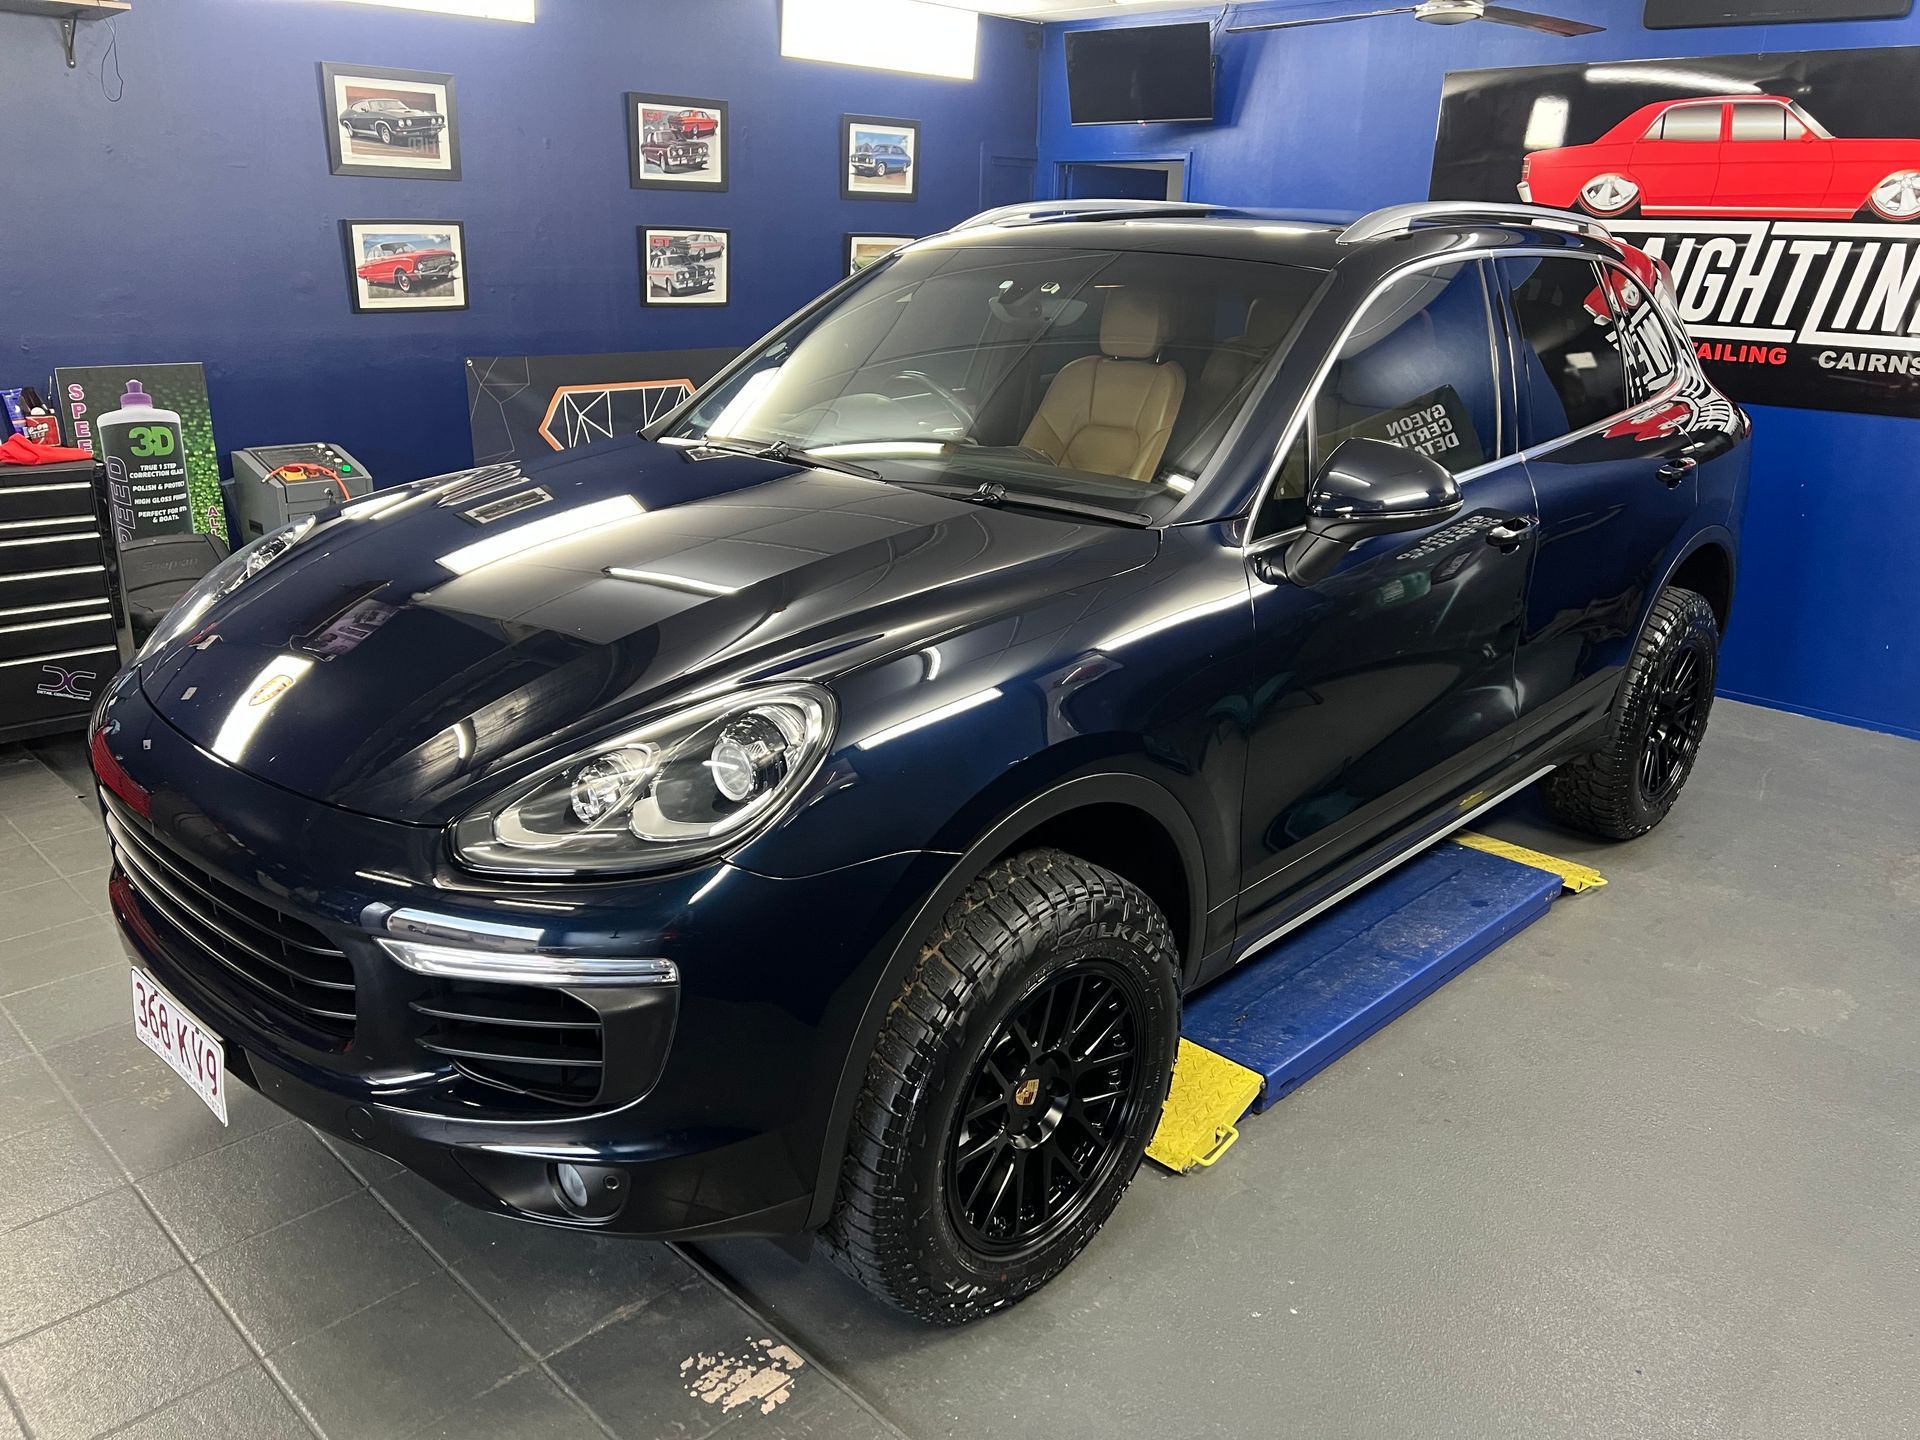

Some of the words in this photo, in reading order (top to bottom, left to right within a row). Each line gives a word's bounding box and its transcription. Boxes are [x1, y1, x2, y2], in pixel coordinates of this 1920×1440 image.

[1818, 350, 1920, 376] CAIRNS
[128, 426, 174, 457] 3D
[163, 462, 177, 470] STEP
[129, 470, 170, 479] CORRECTION
[132, 484, 157, 492] POLISH
[163, 481, 185, 489] PROTECT
[152, 496, 172, 504] GLOSS
[138, 509, 167, 518] PERFECT
[167, 507, 179, 515] FOR
[1051, 922, 1161, 962] FALKEN
